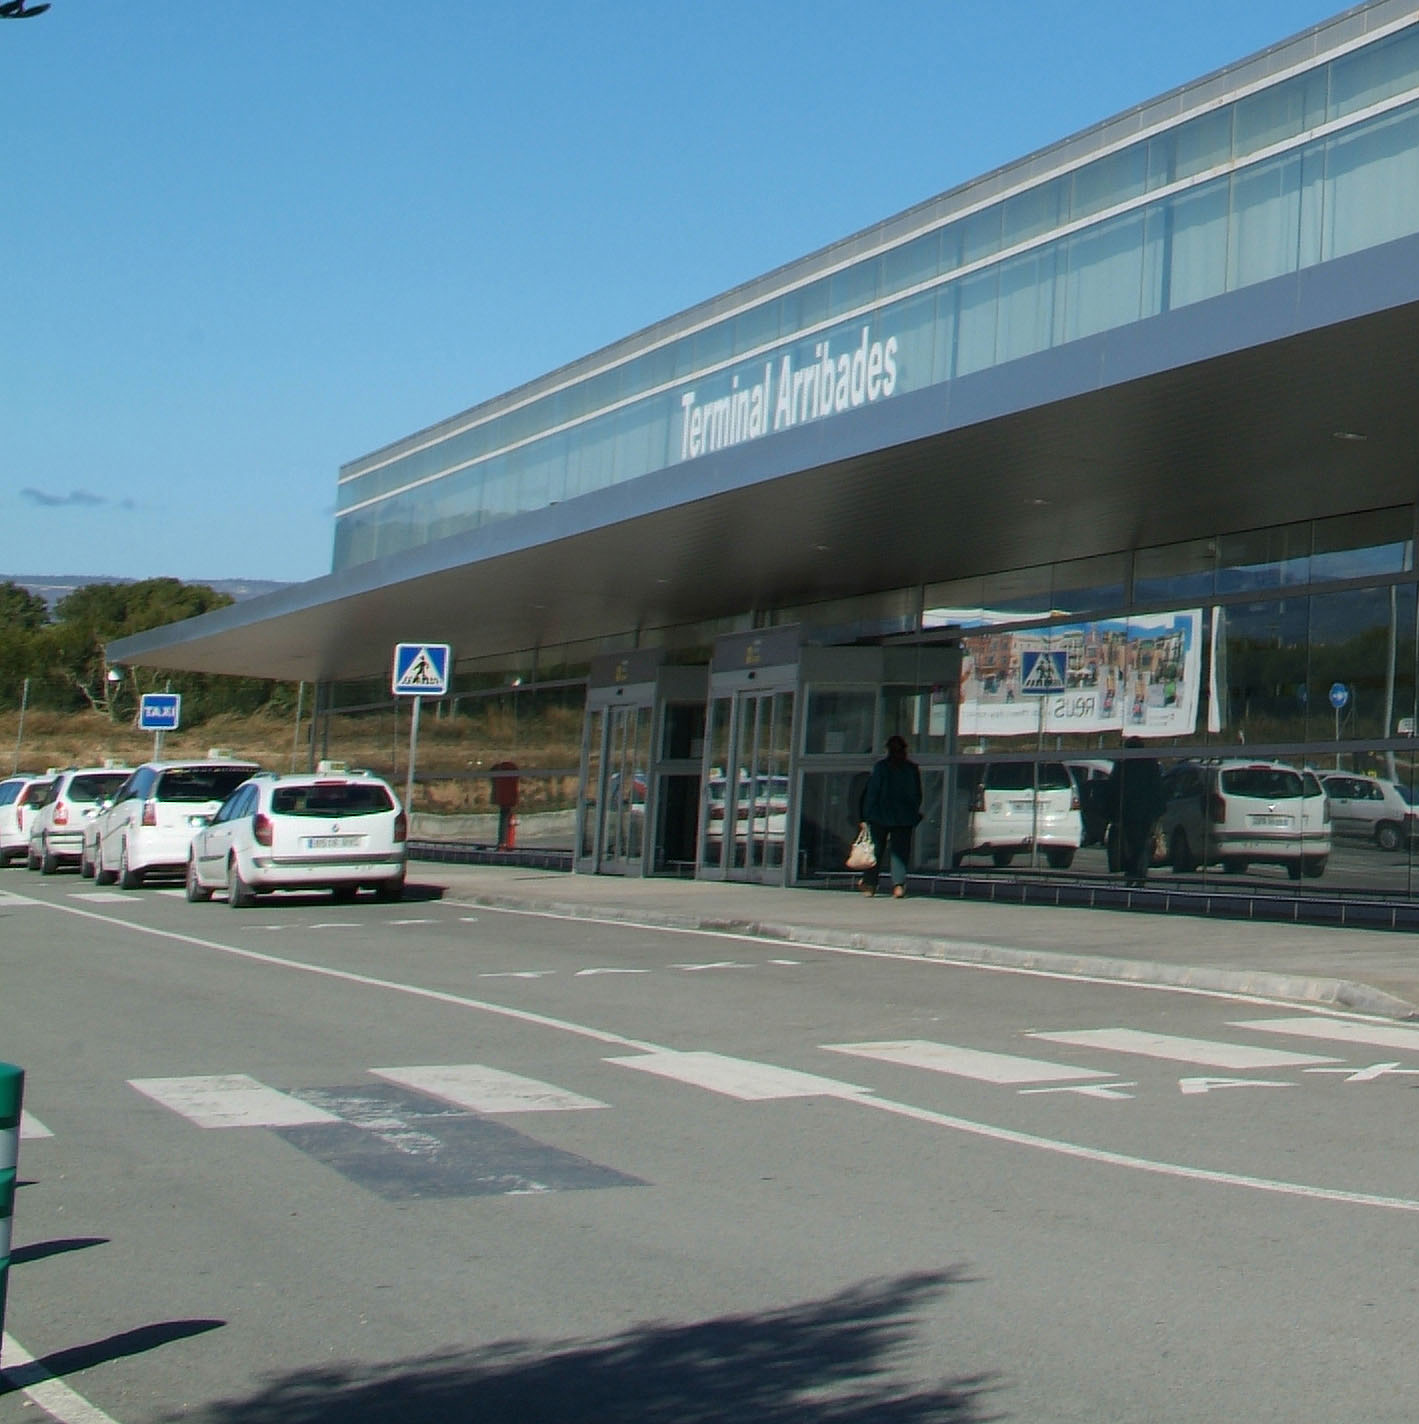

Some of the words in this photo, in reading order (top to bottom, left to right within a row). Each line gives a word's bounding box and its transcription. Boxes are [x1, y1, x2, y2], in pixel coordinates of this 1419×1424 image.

[681, 362, 772, 461] Terminal
[774, 326, 898, 431] Arribades
[143, 705, 176, 717] TAXI
